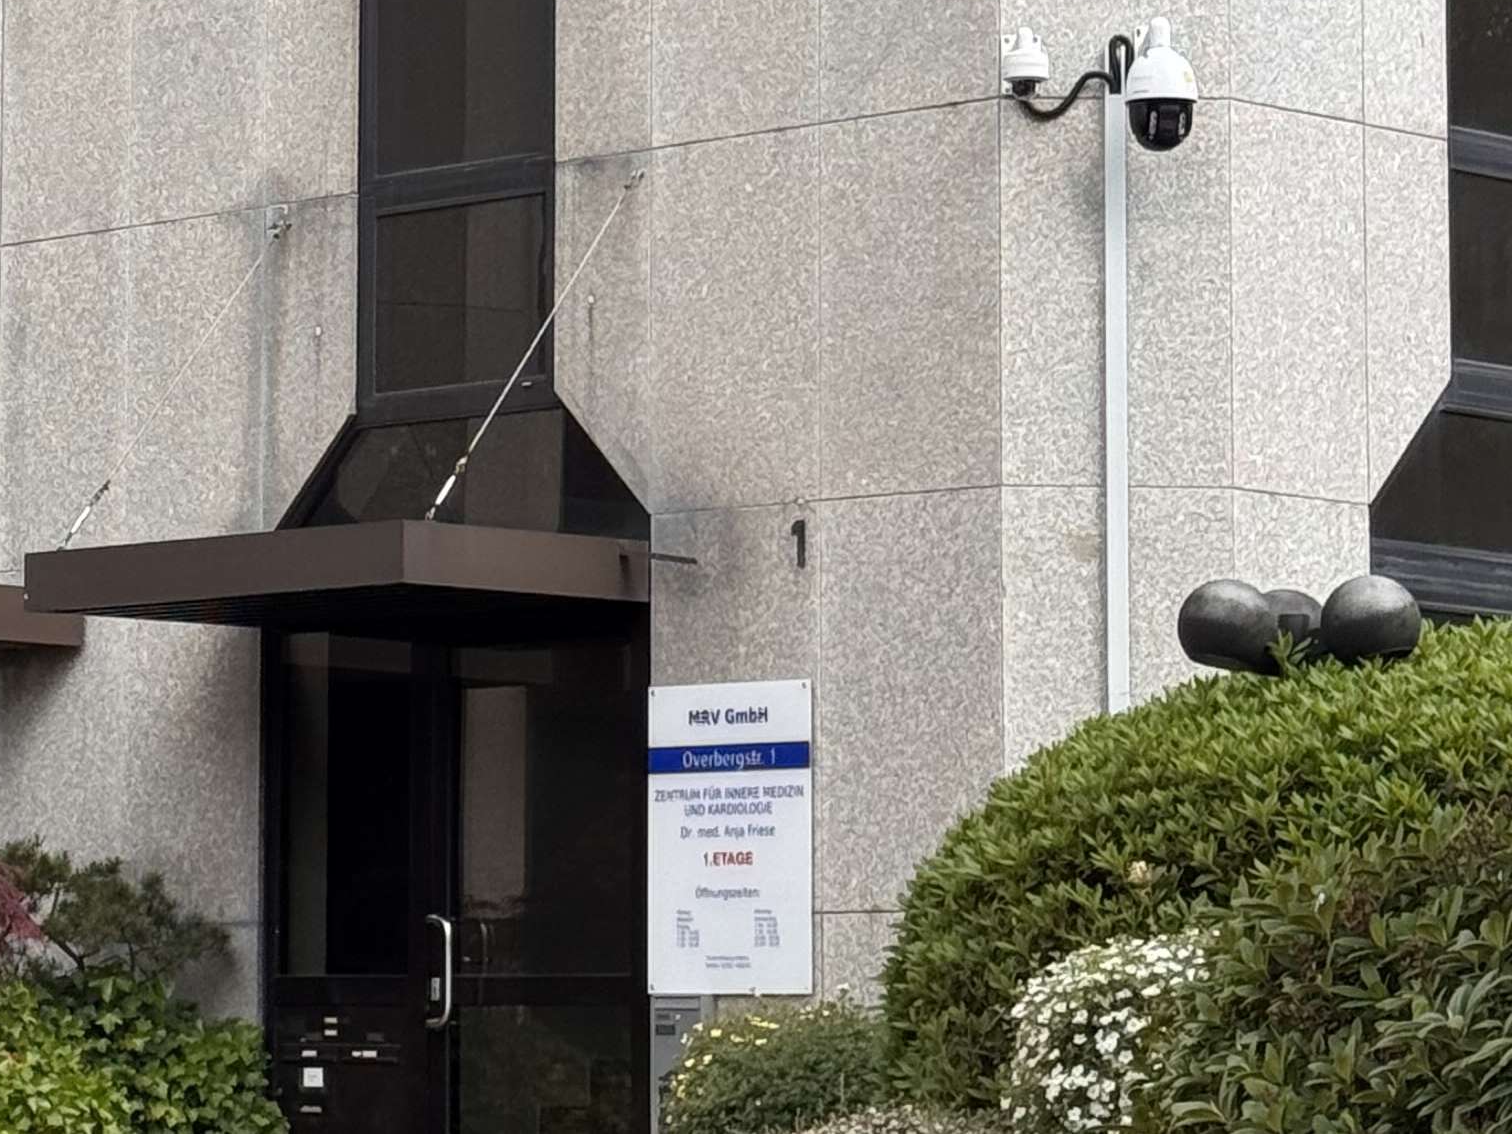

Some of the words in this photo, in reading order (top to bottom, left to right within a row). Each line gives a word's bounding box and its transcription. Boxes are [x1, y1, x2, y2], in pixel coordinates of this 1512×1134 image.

[725, 706, 768, 725] GmbH
[654, 788, 701, 803] ZENTRUM
[703, 786, 722, 801] FÜR
[724, 786, 760, 800] INNERE
[762, 784, 805, 799] MEDIZIN
